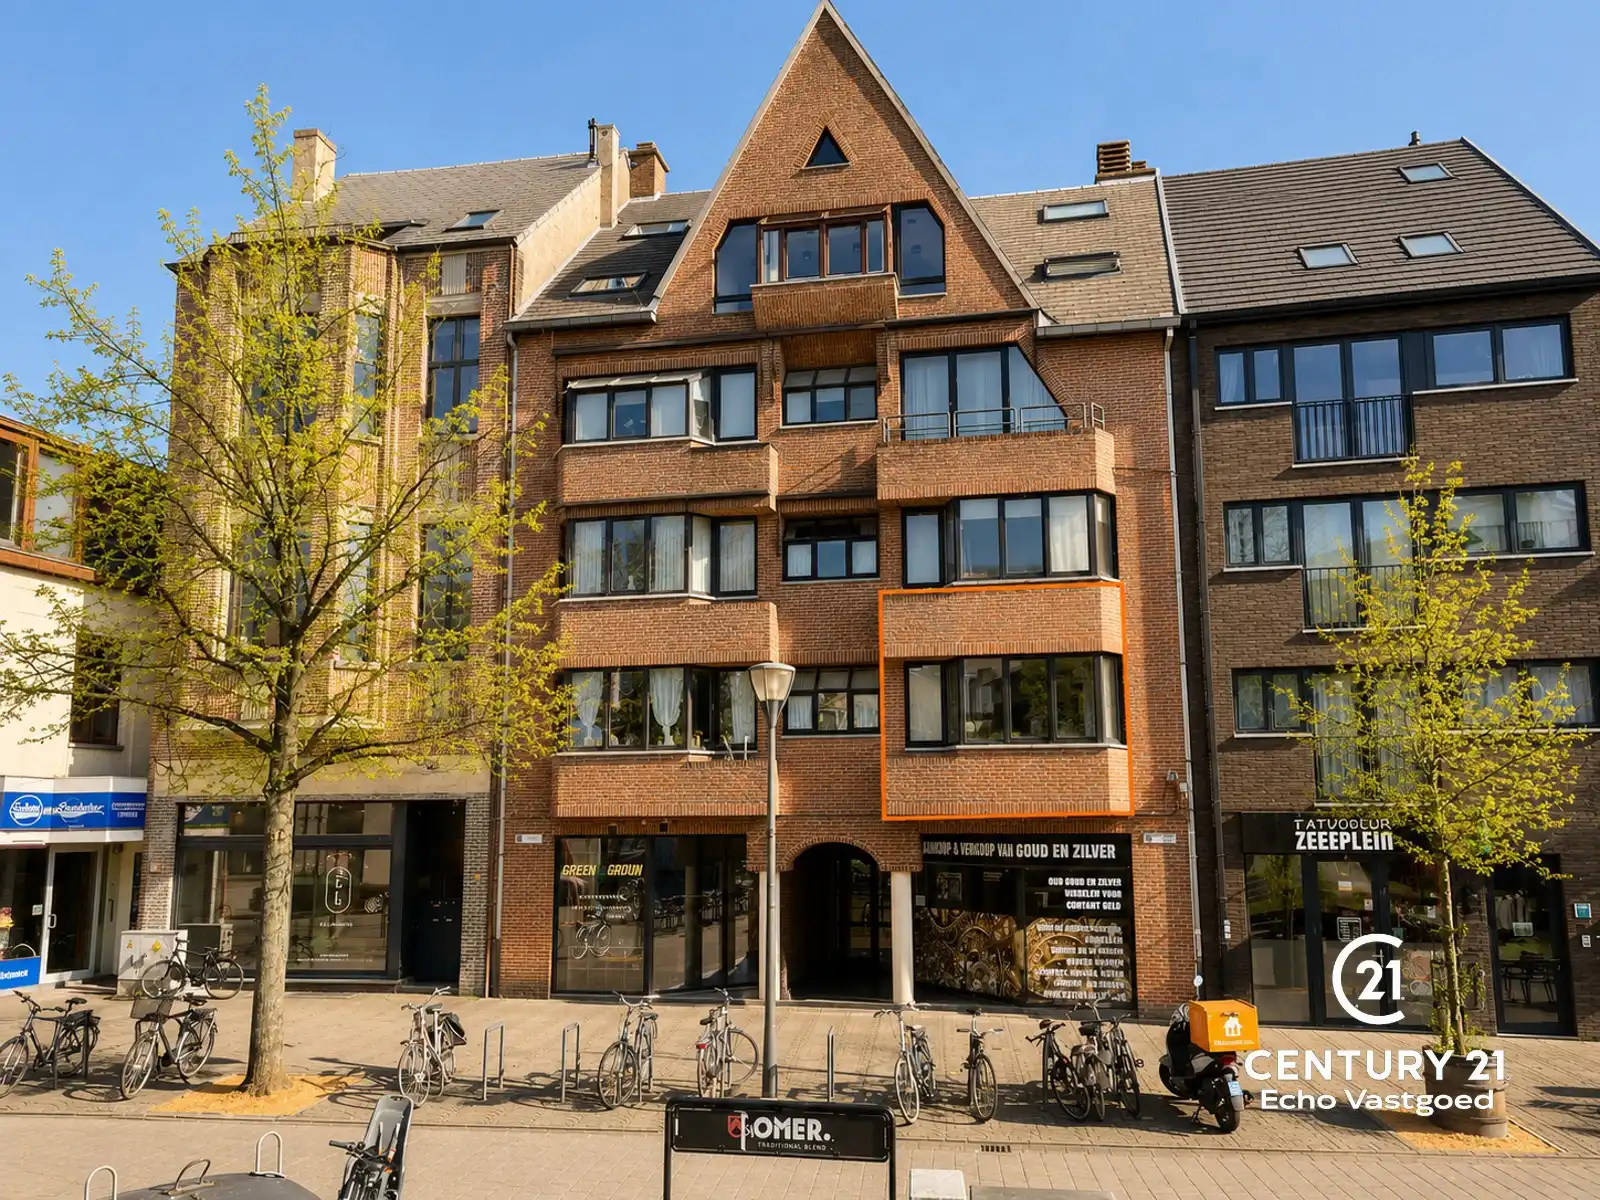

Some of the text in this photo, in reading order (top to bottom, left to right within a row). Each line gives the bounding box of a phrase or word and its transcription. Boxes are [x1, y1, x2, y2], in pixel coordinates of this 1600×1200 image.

[997, 843, 1013, 858] VAN
[1016, 843, 1048, 858] GOUD
[1052, 844, 1069, 858] EN
[1073, 844, 1116, 859] ZILVER
[562, 864, 597, 876] GREEN
